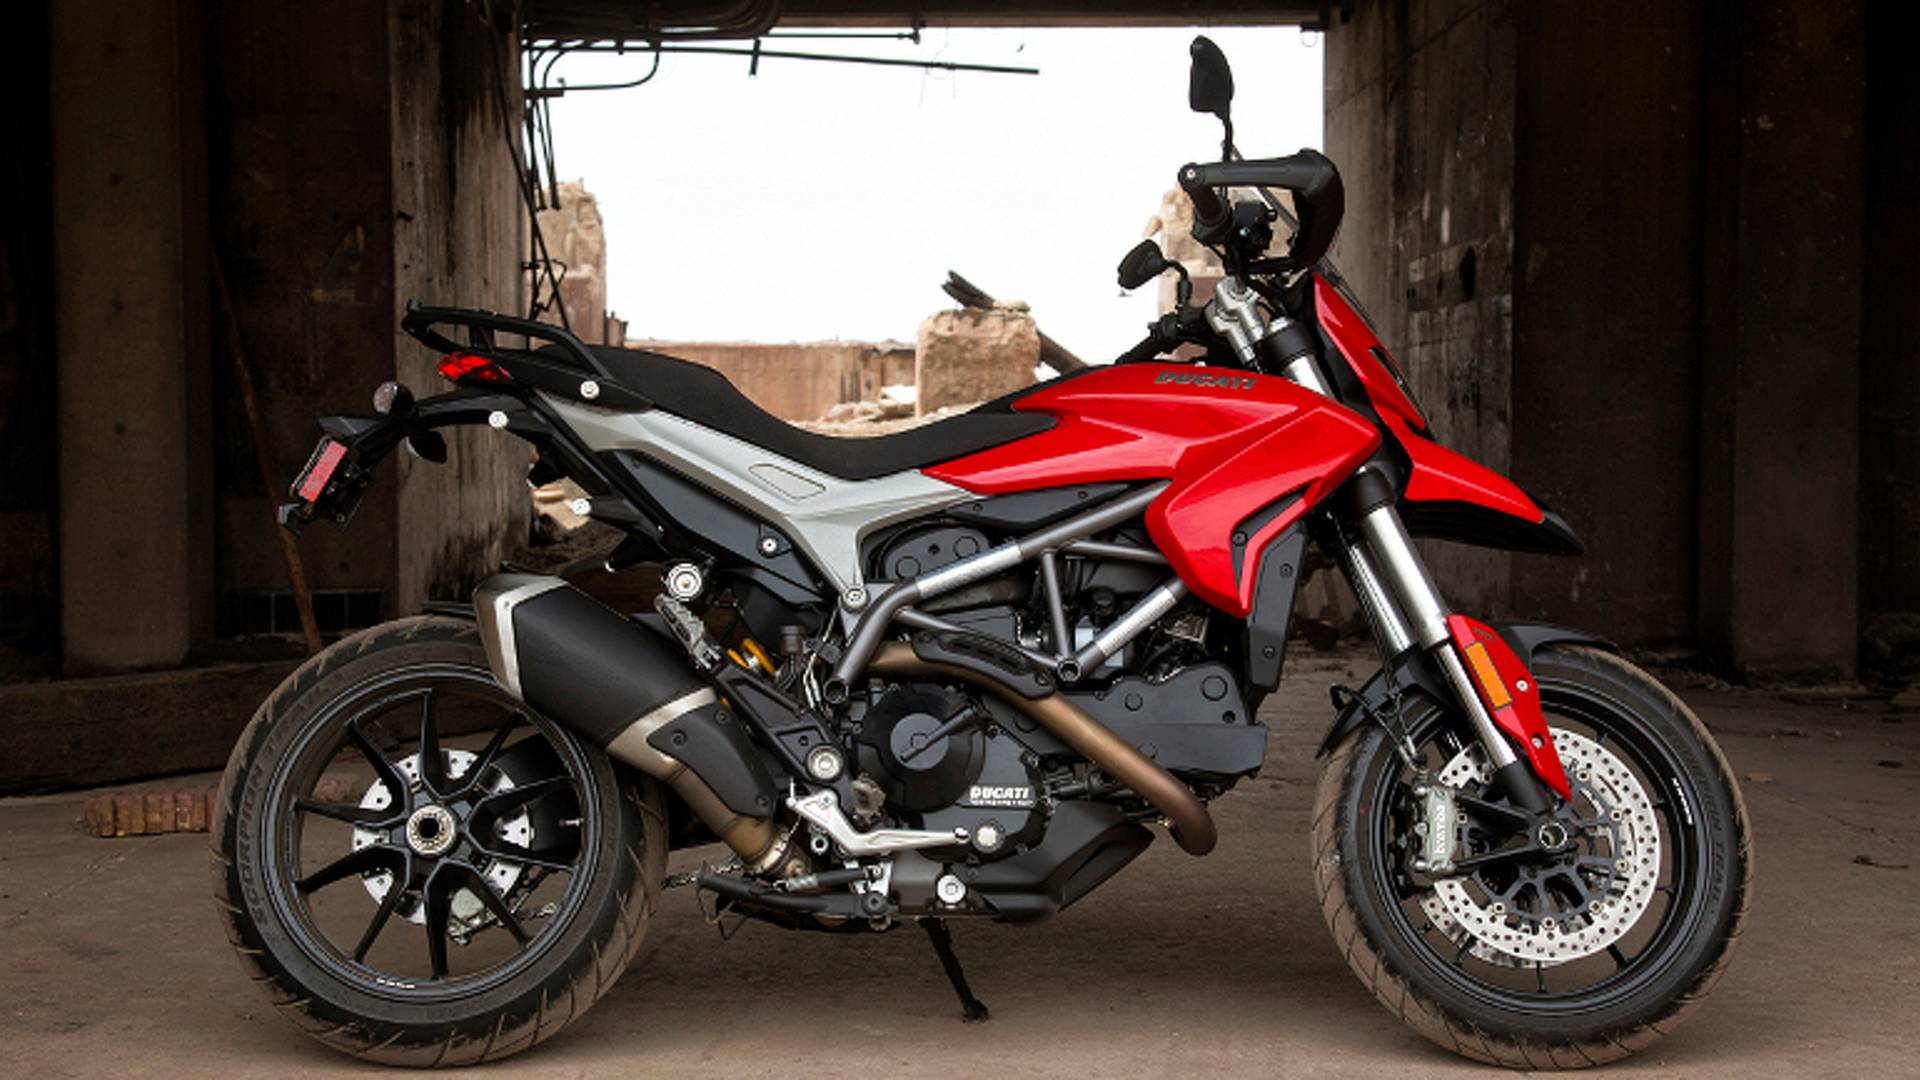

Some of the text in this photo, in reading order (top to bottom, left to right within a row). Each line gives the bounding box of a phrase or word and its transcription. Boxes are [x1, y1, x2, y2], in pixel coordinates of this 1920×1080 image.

[1154, 371, 1257, 390] DUCATI
[970, 785, 1029, 799] DUCATI
[238, 764, 269, 927] SCORPION
[1433, 804, 1446, 854] brembo
[1711, 840, 1725, 902] TRAIL
